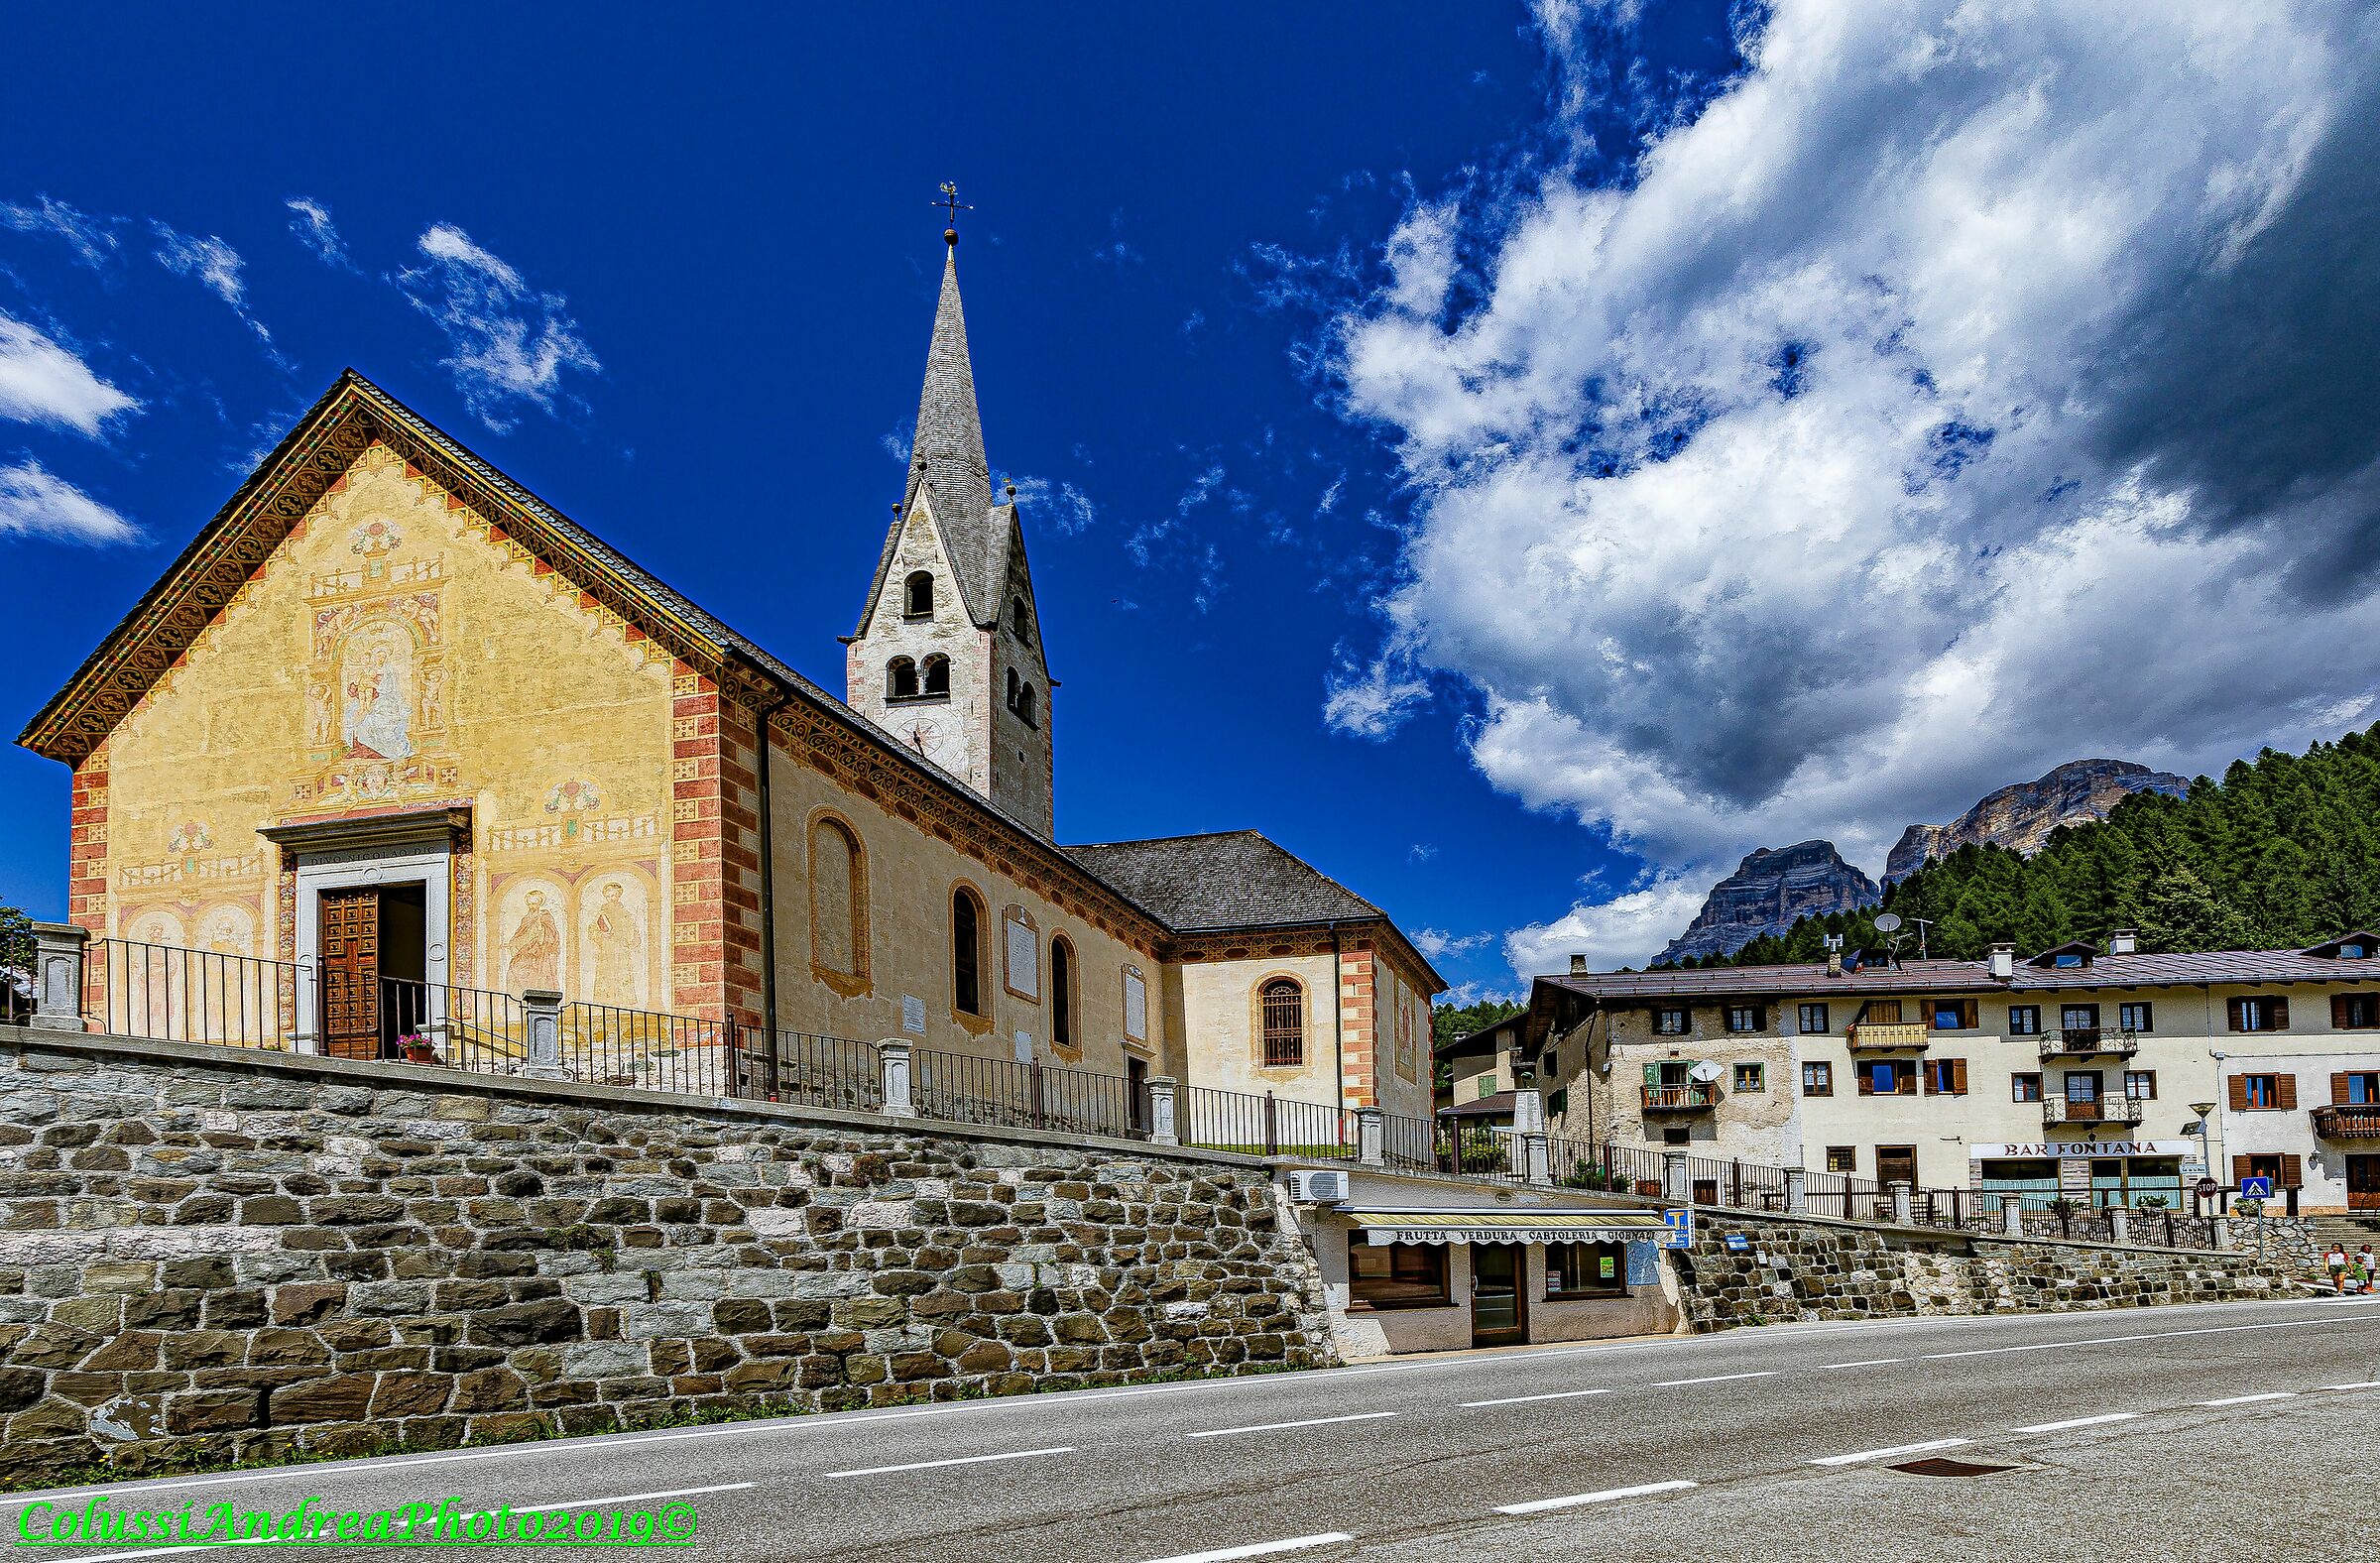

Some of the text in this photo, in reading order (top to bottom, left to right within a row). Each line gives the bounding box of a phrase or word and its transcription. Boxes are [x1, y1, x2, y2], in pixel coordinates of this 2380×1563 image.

[310, 856, 342, 865] DIVO
[348, 849, 408, 862] NICOLAO
[2004, 1142, 2158, 1156] BAR FONTANA
[2198, 1182, 2216, 1192] STOP
[1396, 1231, 1656, 1241] FRUTTA VERDURA CARTOLERIA GIORNALI
